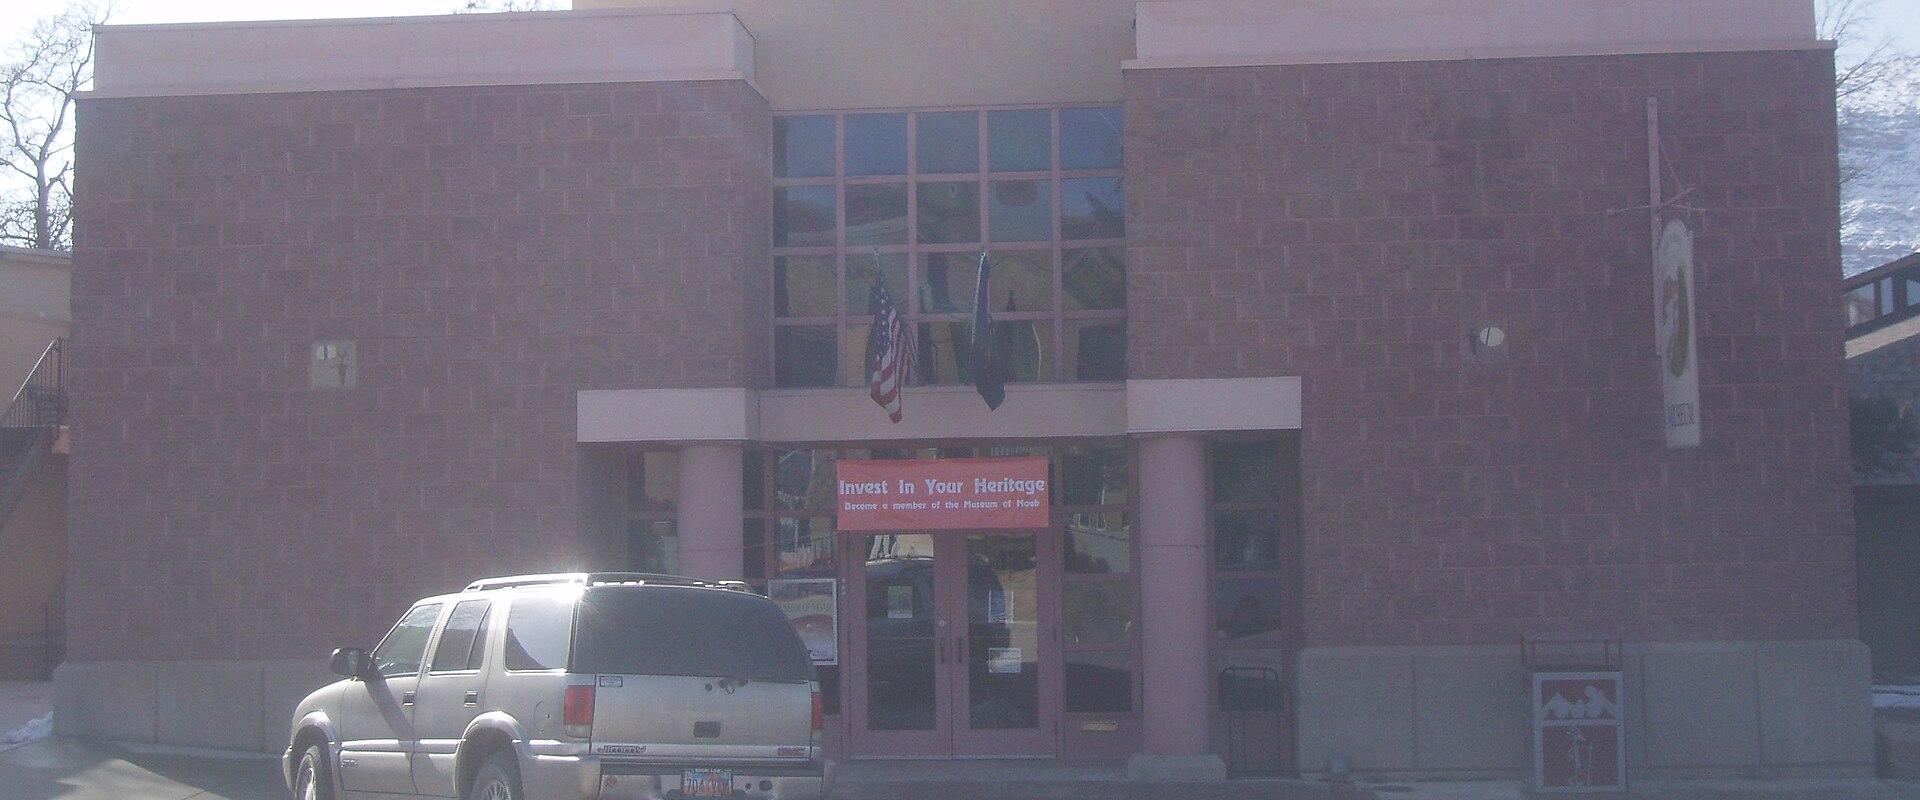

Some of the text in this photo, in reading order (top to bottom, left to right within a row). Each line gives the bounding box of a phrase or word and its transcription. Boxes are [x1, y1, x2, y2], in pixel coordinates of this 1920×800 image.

[839, 478, 1046, 495] Invest In Your Heritage
[844, 502, 878, 511] Become
[892, 502, 926, 510] member
[931, 501, 940, 509] of
[945, 501, 959, 509] the
[963, 500, 998, 509] Museum
[1002, 499, 1012, 508] of
[1016, 499, 1040, 508] Moab
